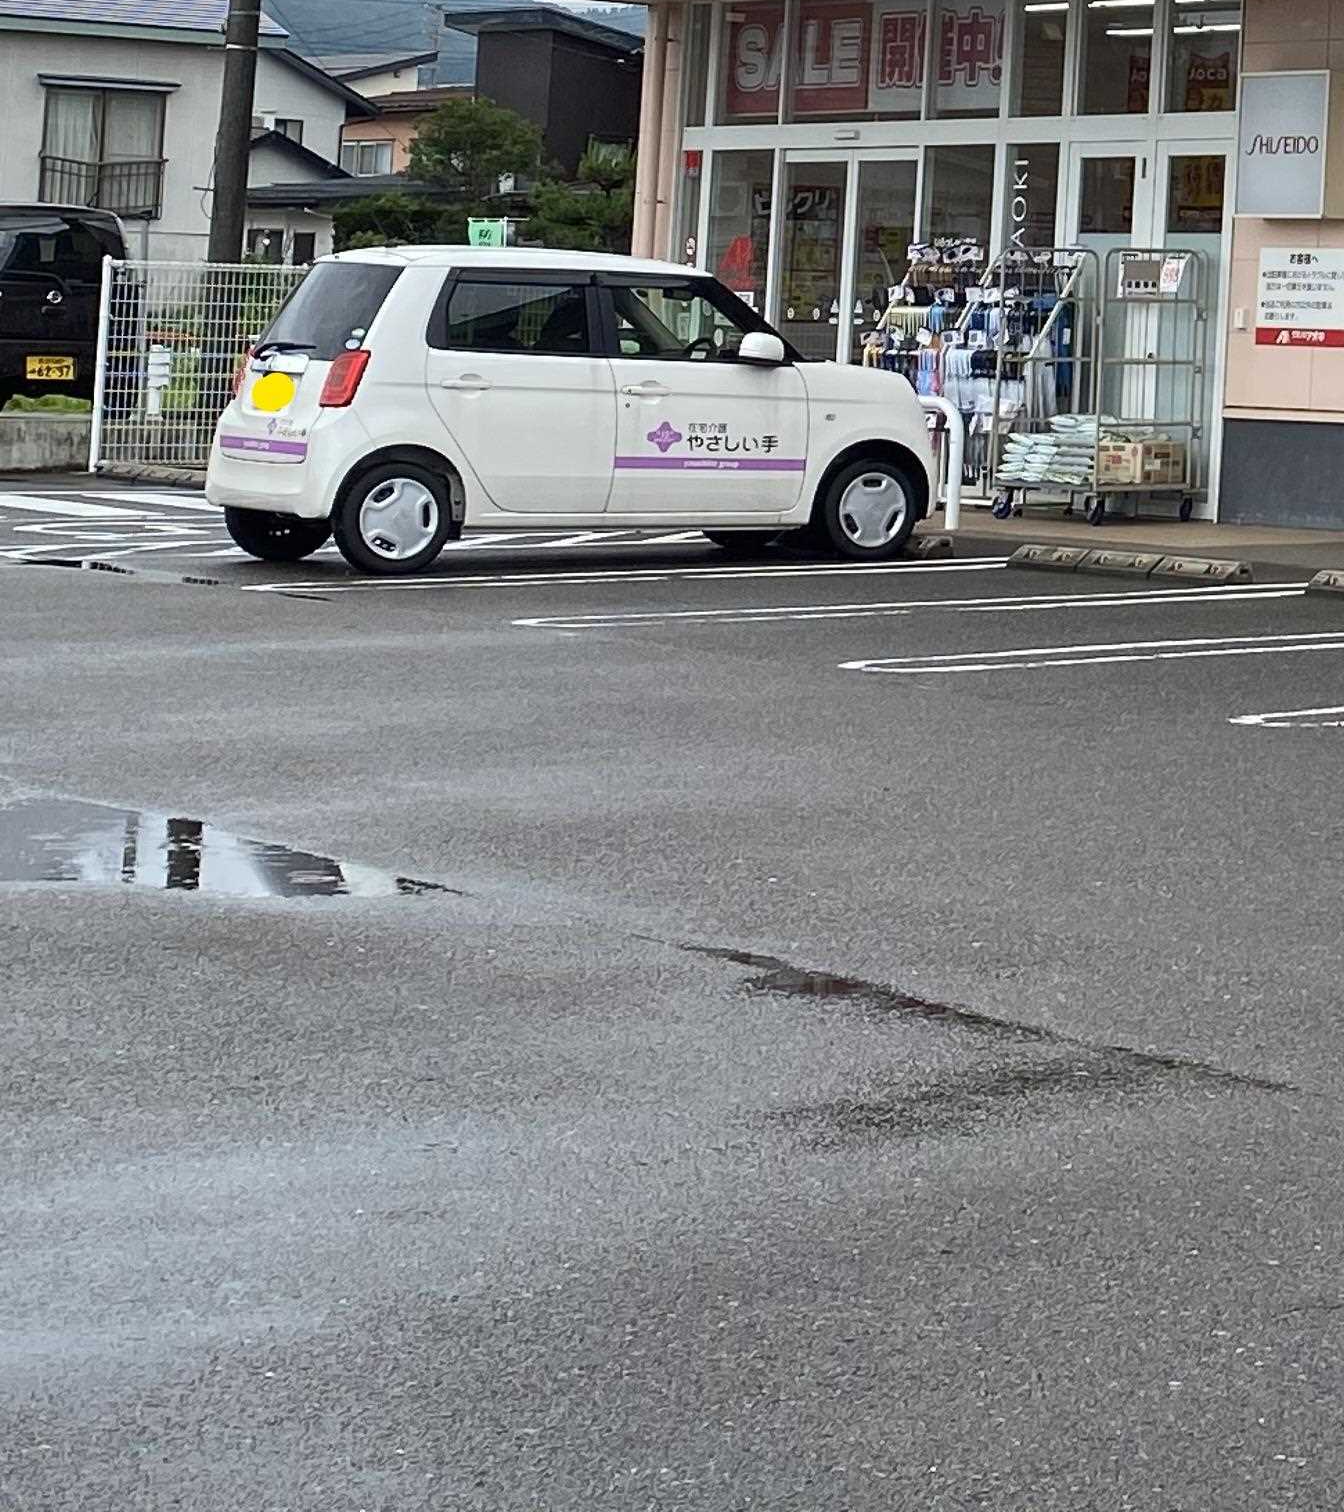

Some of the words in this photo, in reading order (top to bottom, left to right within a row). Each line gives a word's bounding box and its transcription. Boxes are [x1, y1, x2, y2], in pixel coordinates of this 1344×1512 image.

[735, 19, 864, 91] SALE
[1246, 134, 1318, 156] SHISEIDO
[754, 190, 831, 215] ビクリ
[1010, 158, 1029, 248] AOKI
[686, 434, 779, 453] やさしい手
